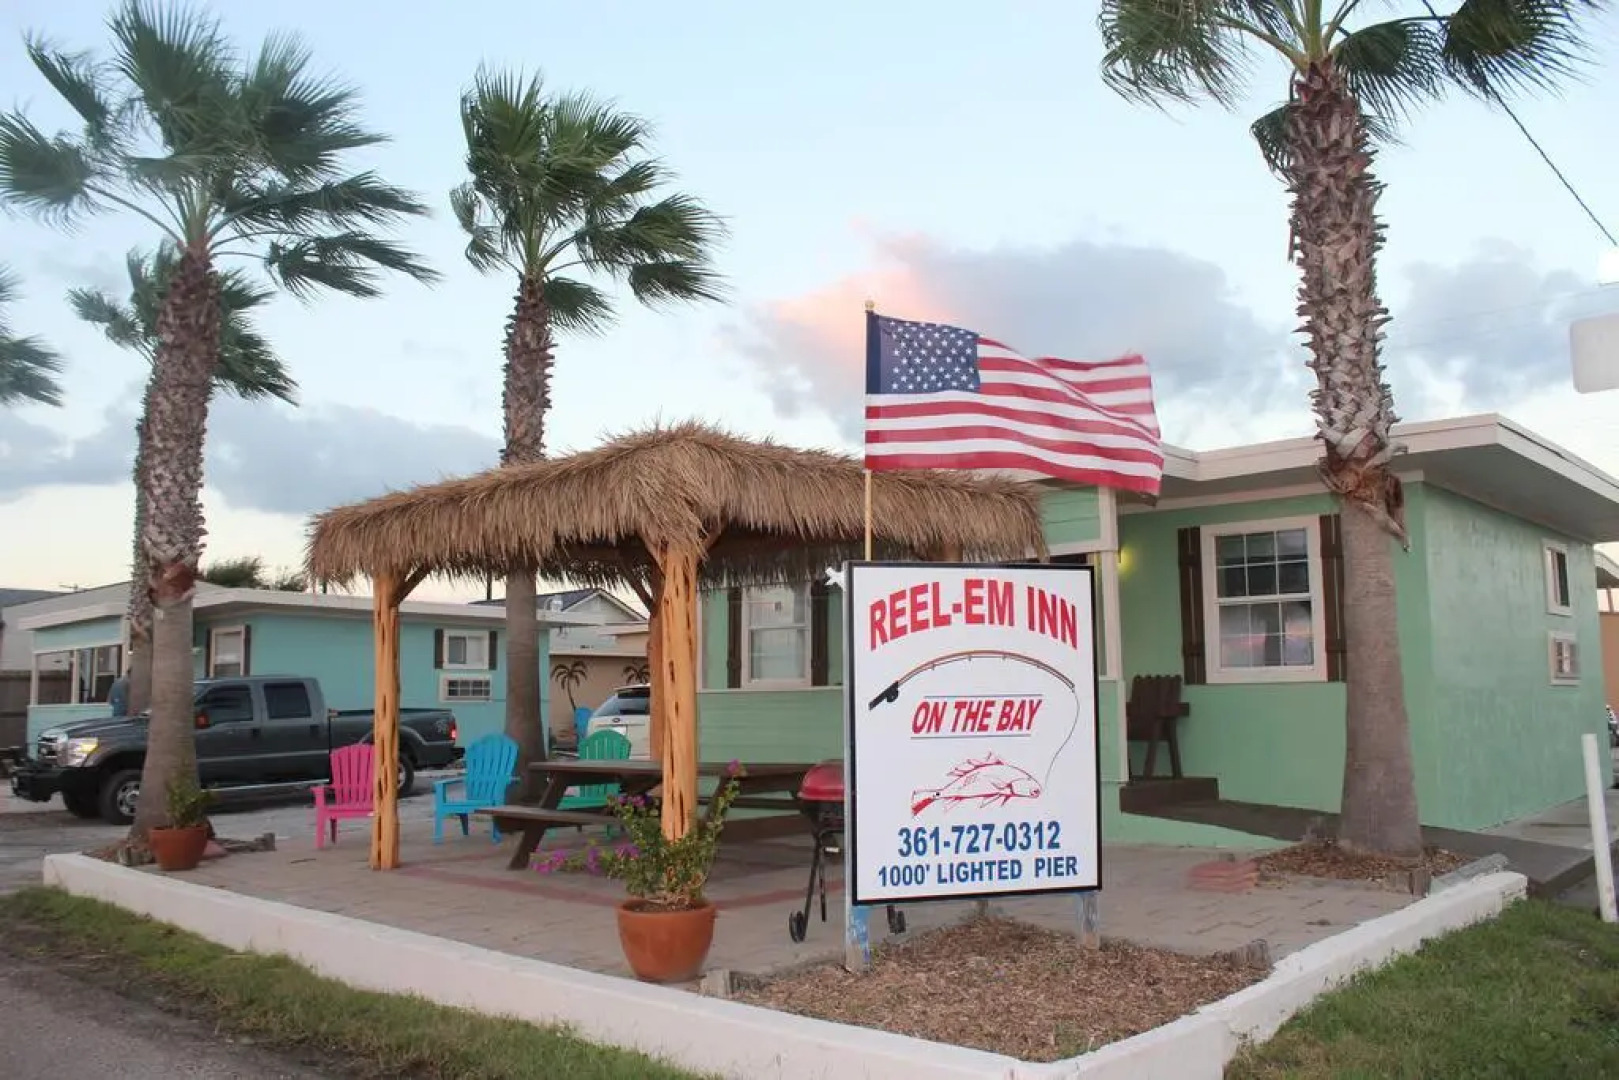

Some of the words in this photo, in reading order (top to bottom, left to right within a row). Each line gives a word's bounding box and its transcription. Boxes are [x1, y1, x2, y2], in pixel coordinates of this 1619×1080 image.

[869, 578, 1016, 651] REEL-EM
[1026, 586, 1079, 650] INN
[911, 701, 945, 735] ON
[951, 700, 994, 733] THE
[995, 699, 1043, 732] BAY
[898, 821, 1062, 858] 361-727-0312
[936, 859, 1023, 885] LIGHTED
[1034, 856, 1078, 878] PIER
